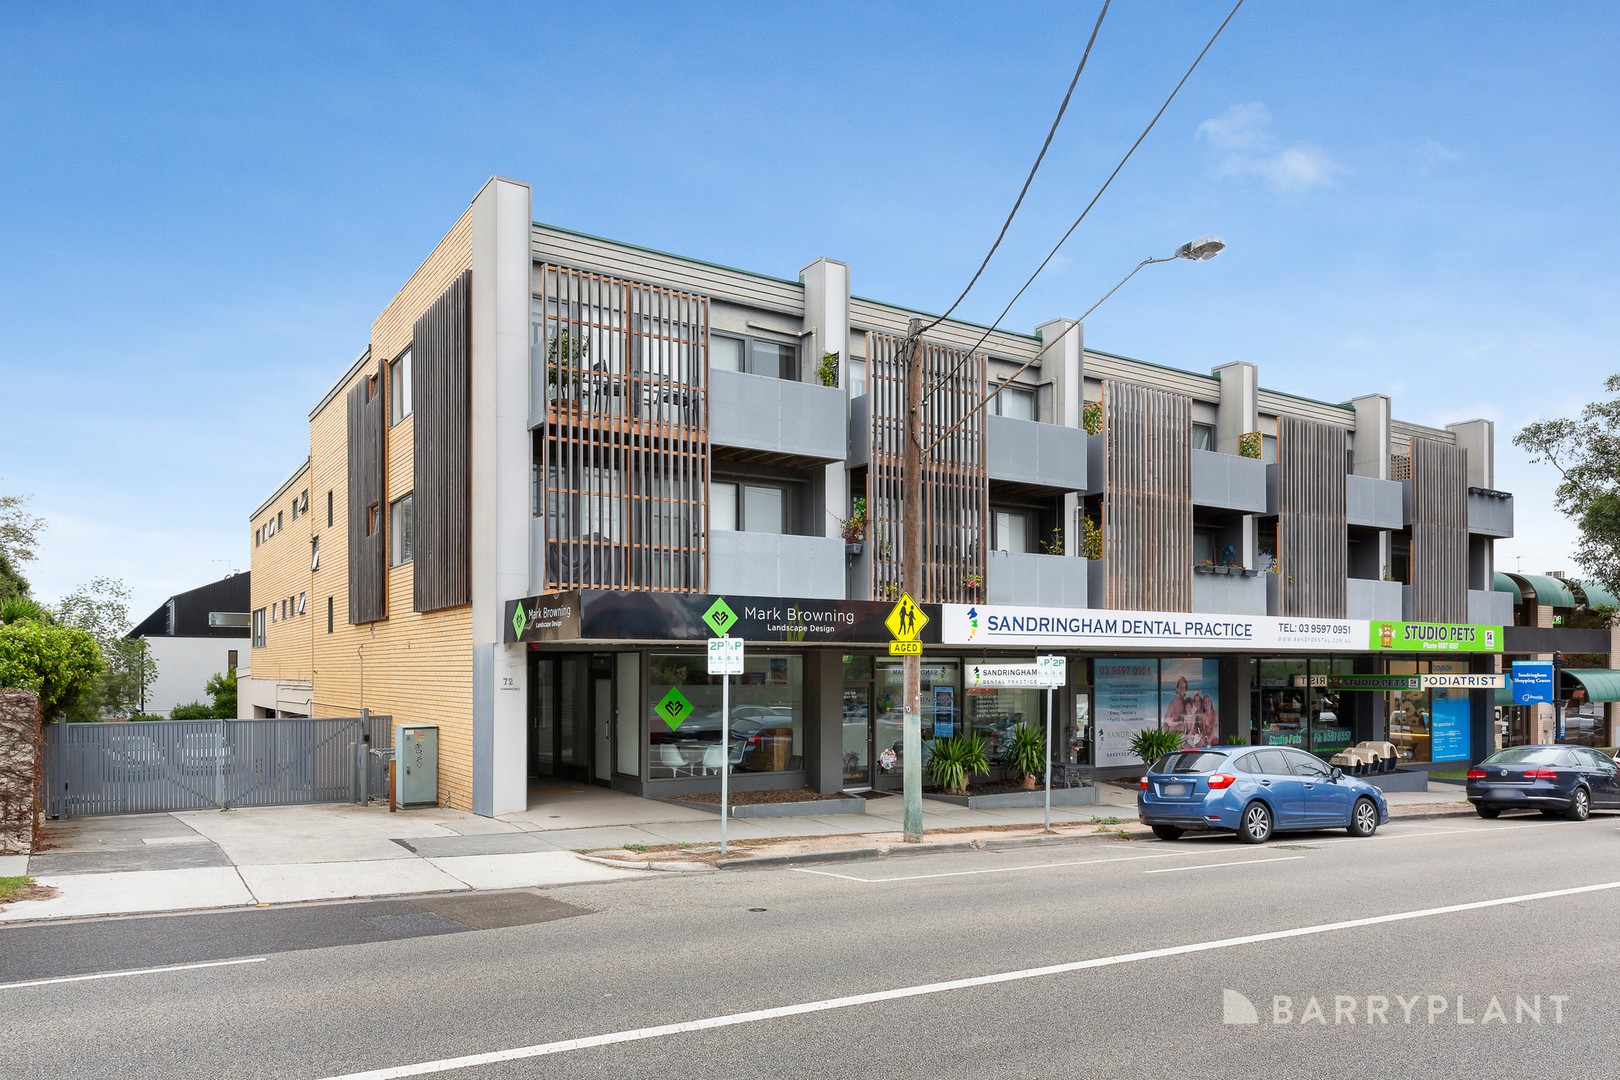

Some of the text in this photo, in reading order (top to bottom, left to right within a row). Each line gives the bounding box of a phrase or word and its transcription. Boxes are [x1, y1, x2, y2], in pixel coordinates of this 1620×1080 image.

[529, 606, 570, 619] Mark Browning
[745, 607, 854, 624] Mark Browning
[767, 624, 834, 633] Landscape Design
[988, 616, 1252, 637] SANDRINGHAM DENTAL PRACTICE
[1279, 623, 1350, 634] TEL: 03 9597 0951
[1404, 625, 1475, 642] STUDIO PETS
[710, 642, 724, 650] 2P
[894, 644, 917, 652] AGED
[1053, 659, 1064, 667] 2P
[1100, 666, 1151, 674] 03 9597 0951
[503, 678, 513, 686] 72
[1344, 679, 1379, 687] STUDIO
[1425, 676, 1496, 686] PODIATRIST
